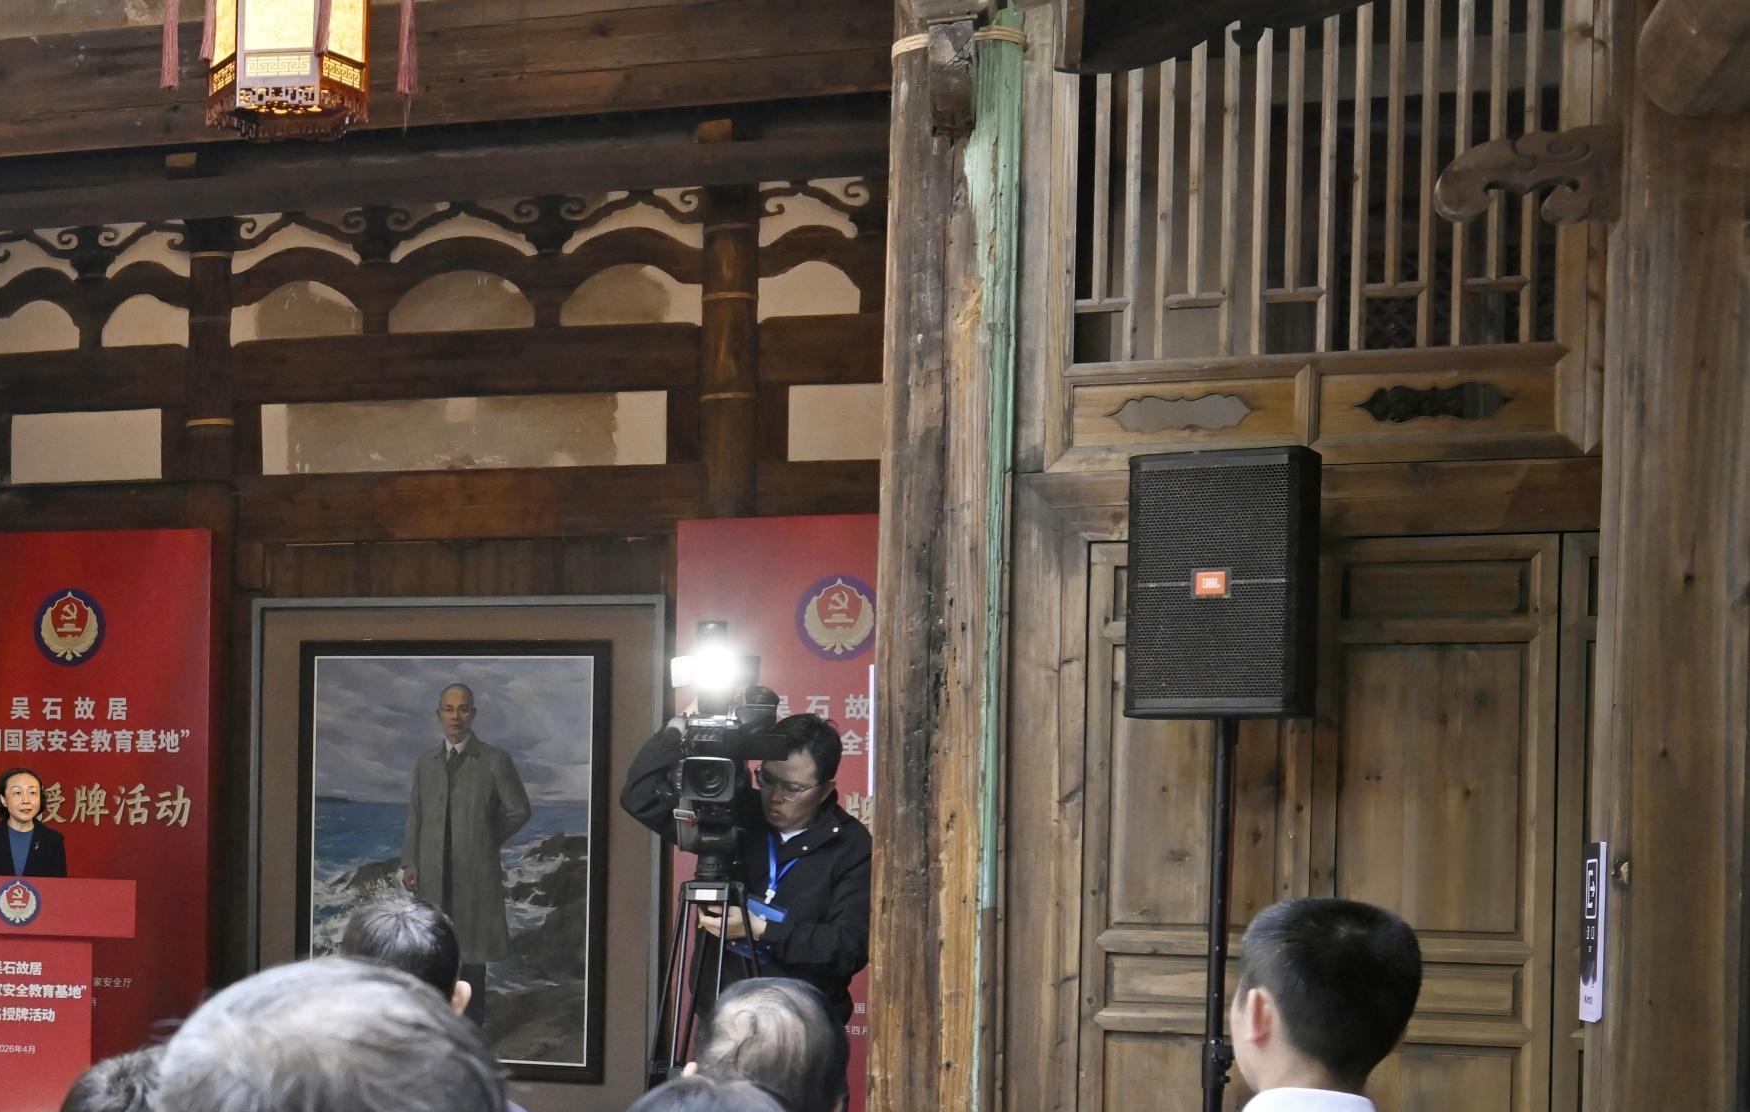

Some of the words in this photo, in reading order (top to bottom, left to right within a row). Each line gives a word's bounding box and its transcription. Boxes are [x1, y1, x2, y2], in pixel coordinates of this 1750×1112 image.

[1201, 577, 1221, 589] JBL
[10, 696, 128, 721] 吴石故居
